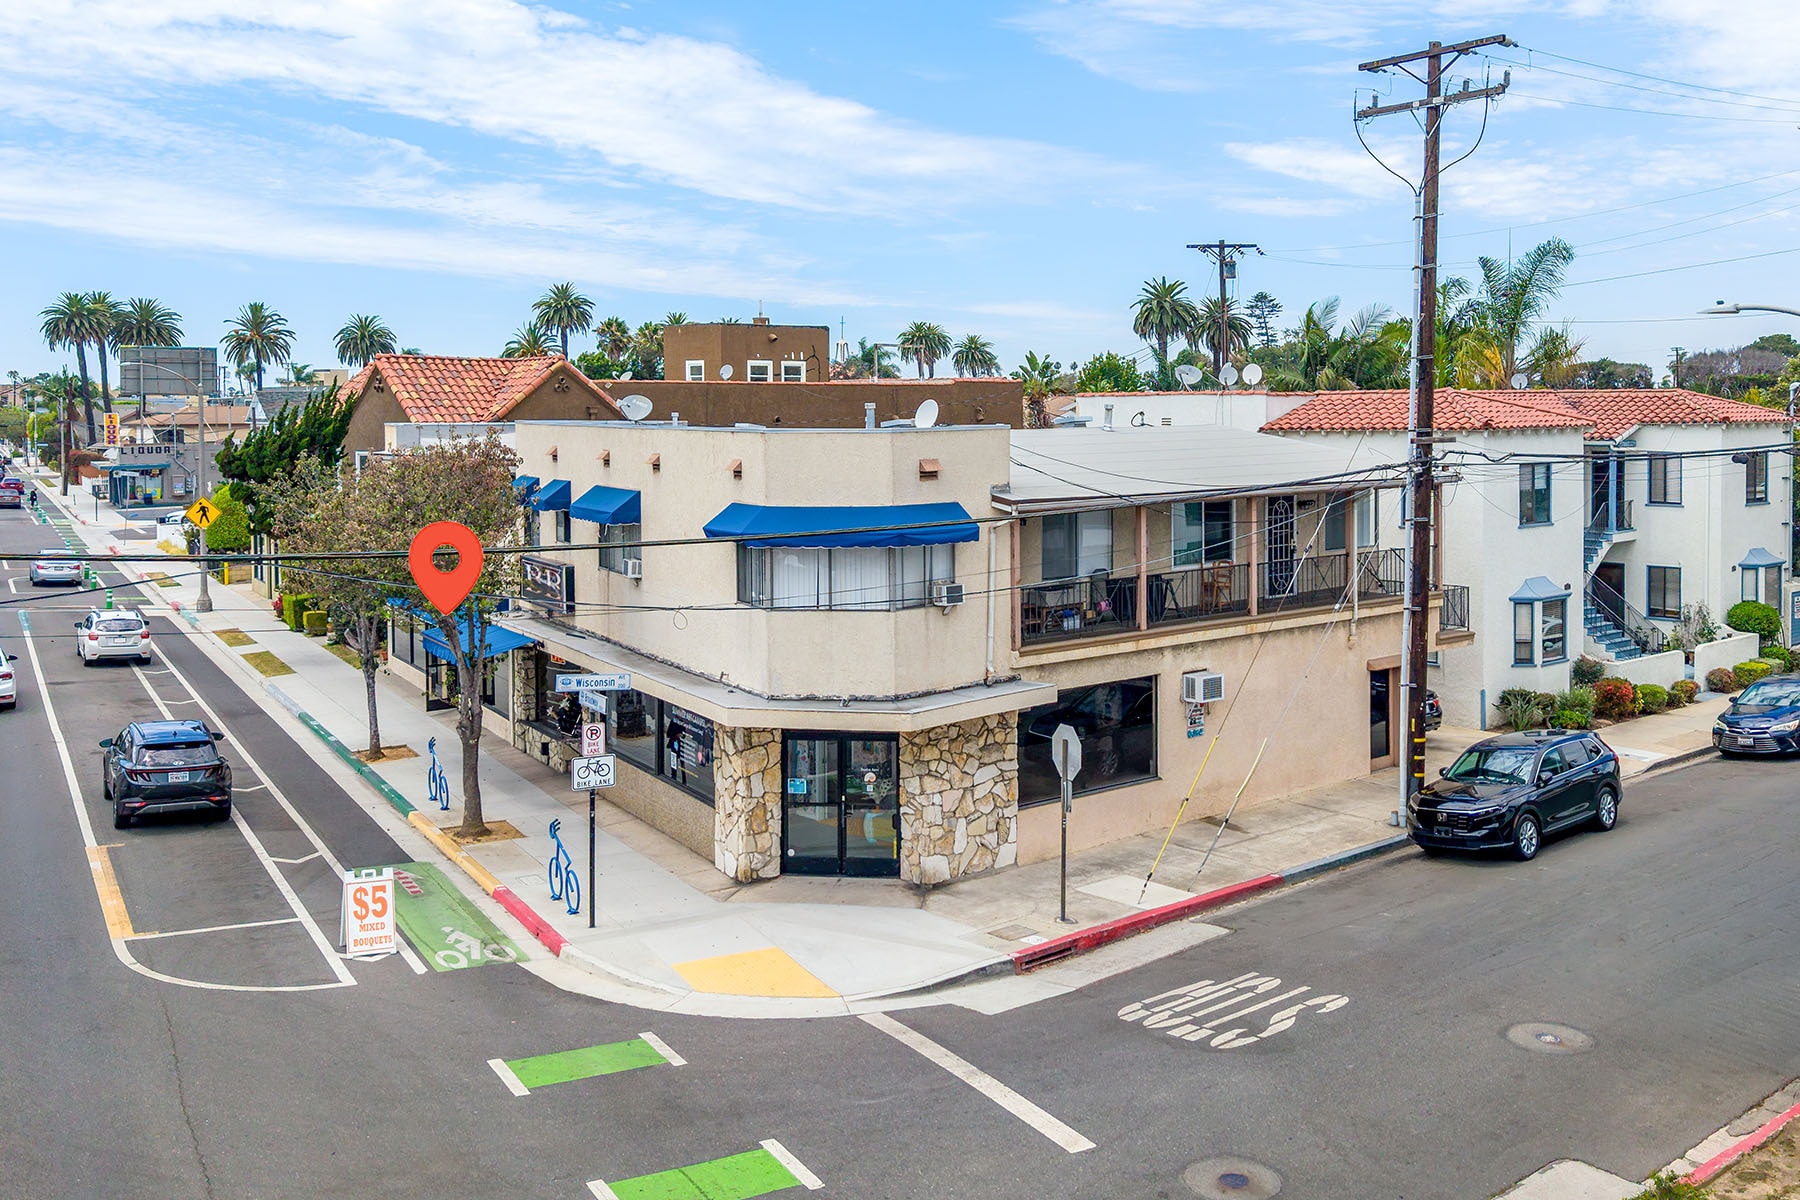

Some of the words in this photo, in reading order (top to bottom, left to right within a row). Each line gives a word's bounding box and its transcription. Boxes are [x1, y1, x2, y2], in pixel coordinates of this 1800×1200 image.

[107, 414, 117, 444] LIQUOR
[121, 446, 171, 455] LIQUOR
[576, 678, 615, 688] Wisconsin
[587, 747, 600, 755] LANE
[576, 780, 591, 788] BIKE
[594, 778, 611, 786] LANE
[353, 885, 388, 923] $5
[359, 922, 386, 932] MIXED
[353, 935, 393, 947] BOUQUETS
